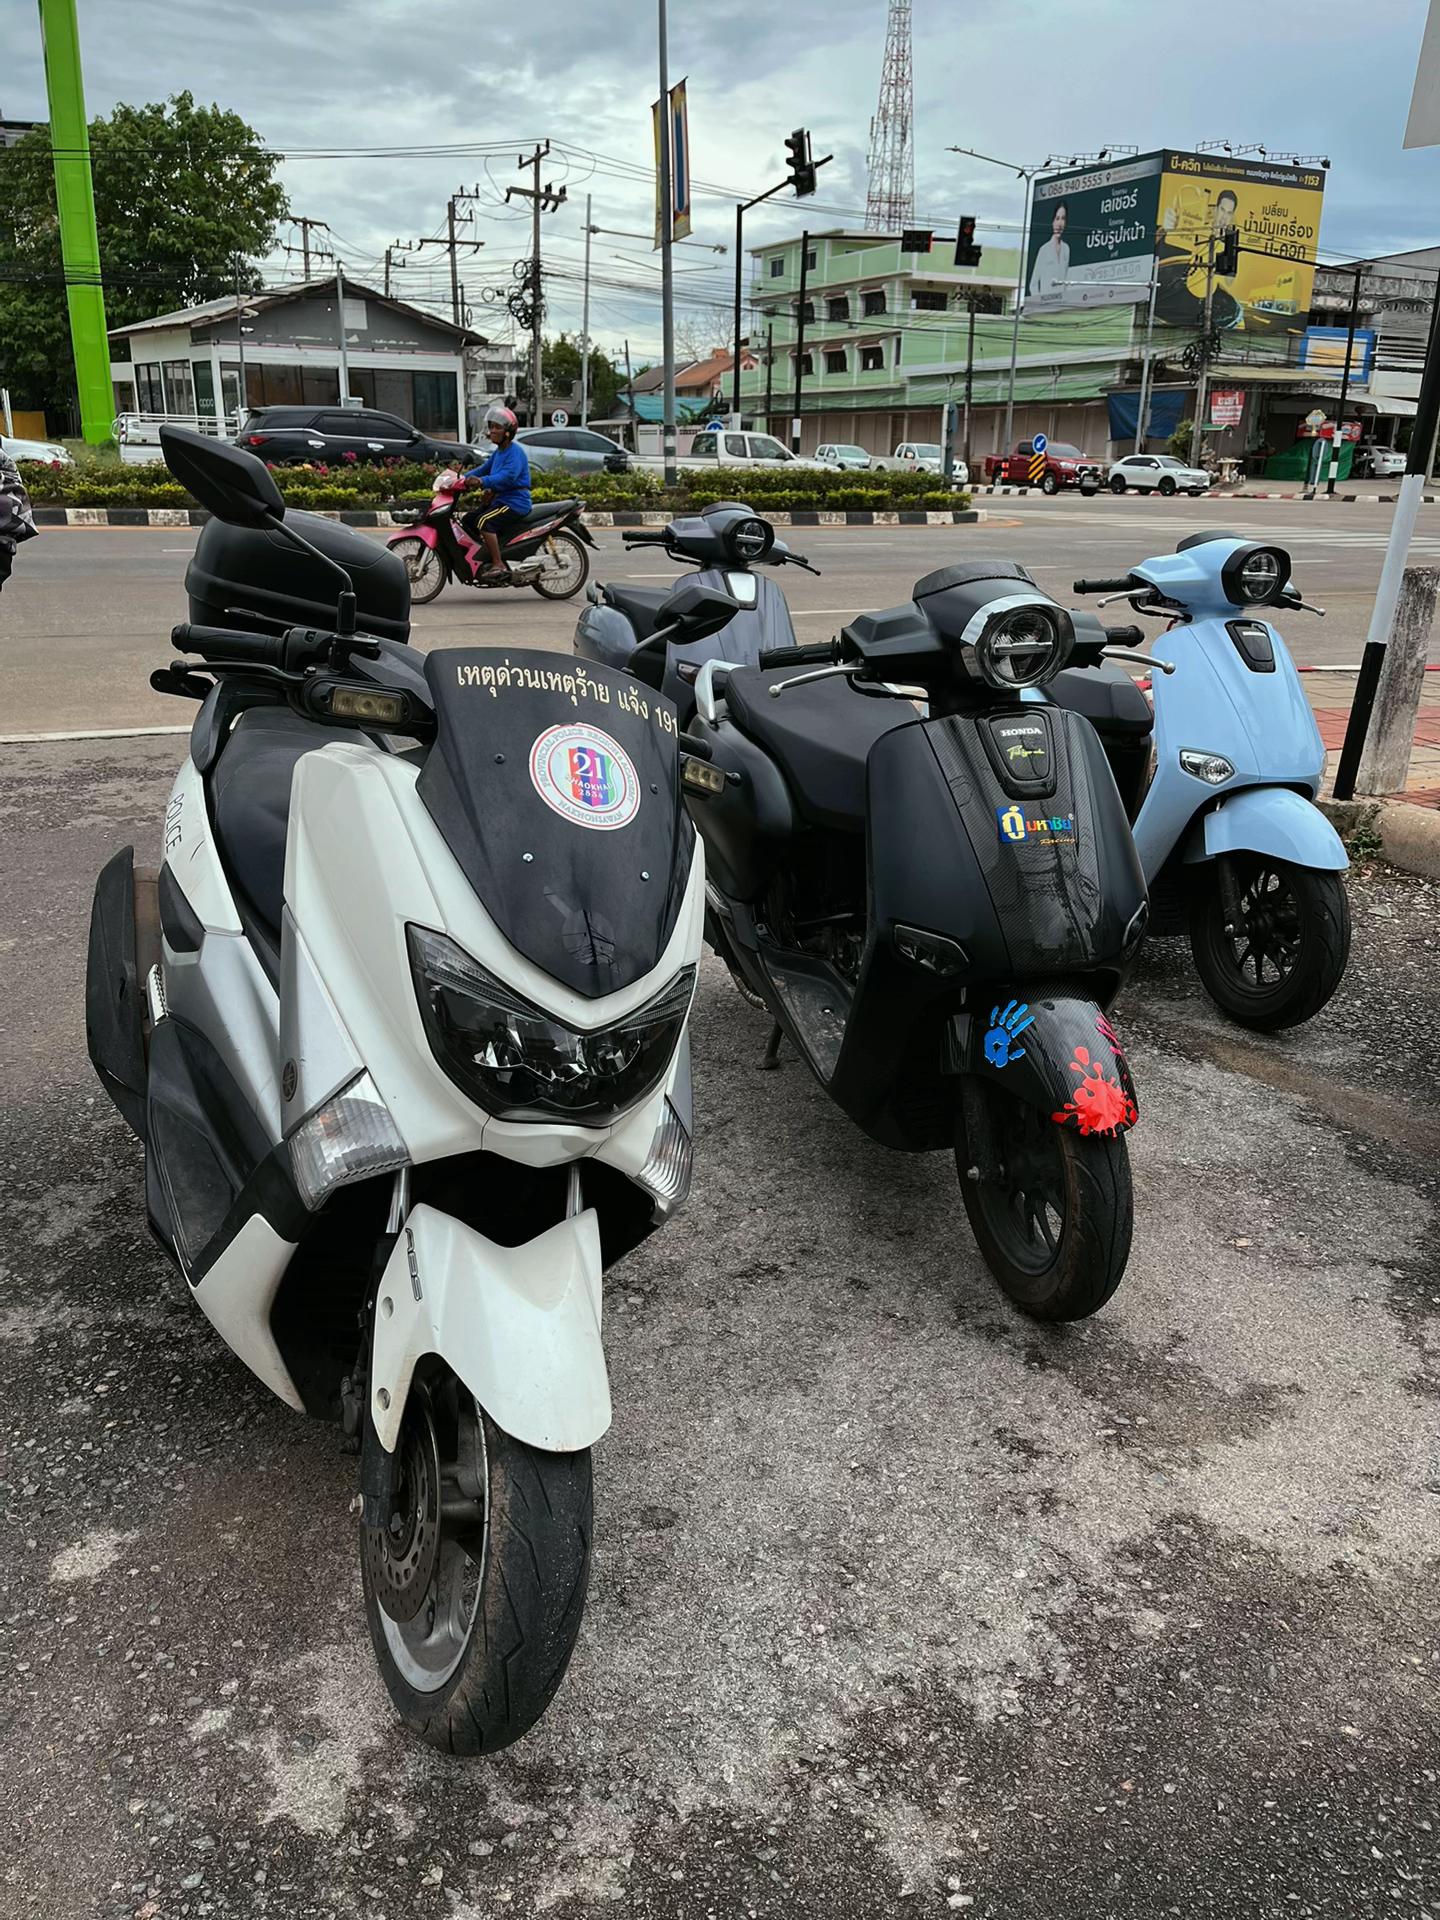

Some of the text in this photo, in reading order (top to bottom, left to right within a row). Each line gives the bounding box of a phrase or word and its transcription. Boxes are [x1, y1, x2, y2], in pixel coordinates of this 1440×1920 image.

[1170, 155, 1200, 172] บี-ควิก
[1047, 175, 1103, 197] 086 940 5555
[1303, 174, 1320, 186] 1153
[1243, 210, 1314, 239] น้ำมันเครื่อง
[553, 413, 566, 424] 45
[456, 658, 678, 738] เหตุด่วนเหตุร้าย แจ้ง 191
[1000, 727, 1043, 737] HONDA
[572, 752, 604, 779] 21
[165, 792, 185, 855] POLICE
